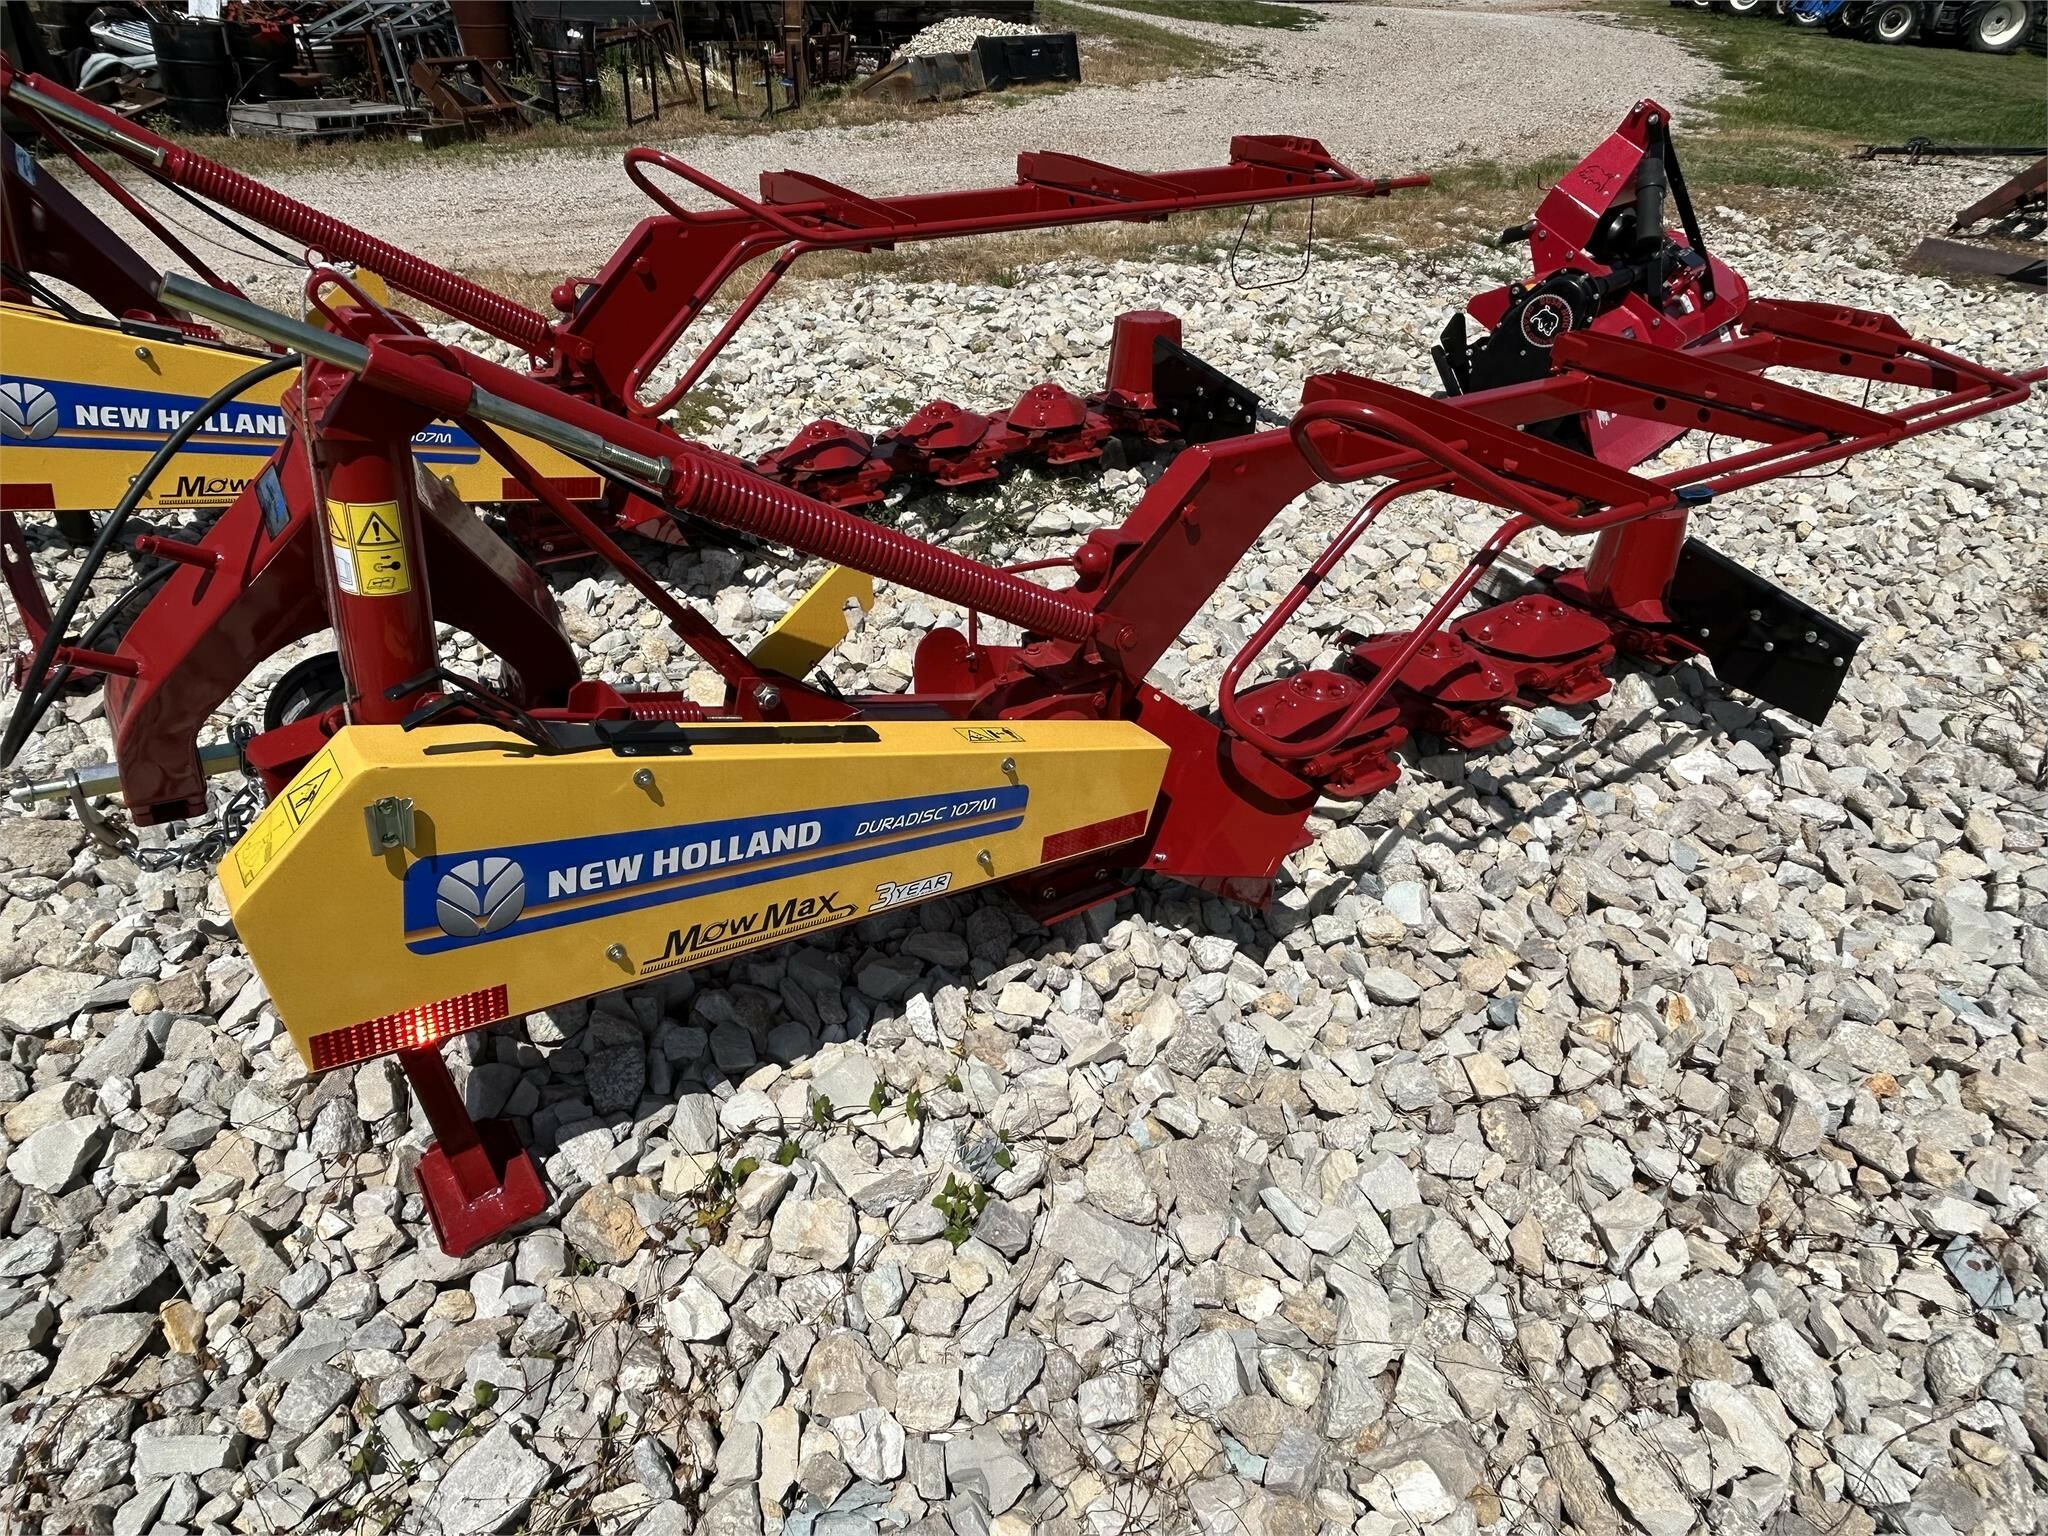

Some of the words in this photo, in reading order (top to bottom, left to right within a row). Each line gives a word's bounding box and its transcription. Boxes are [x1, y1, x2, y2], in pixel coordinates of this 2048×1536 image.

[75, 405, 150, 429] NEW
[855, 806, 947, 836] DURADISC
[950, 797, 996, 818] 107M
[548, 854, 644, 898] NEW
[653, 820, 822, 877] HOLLAND
[760, 890, 840, 930] Max
